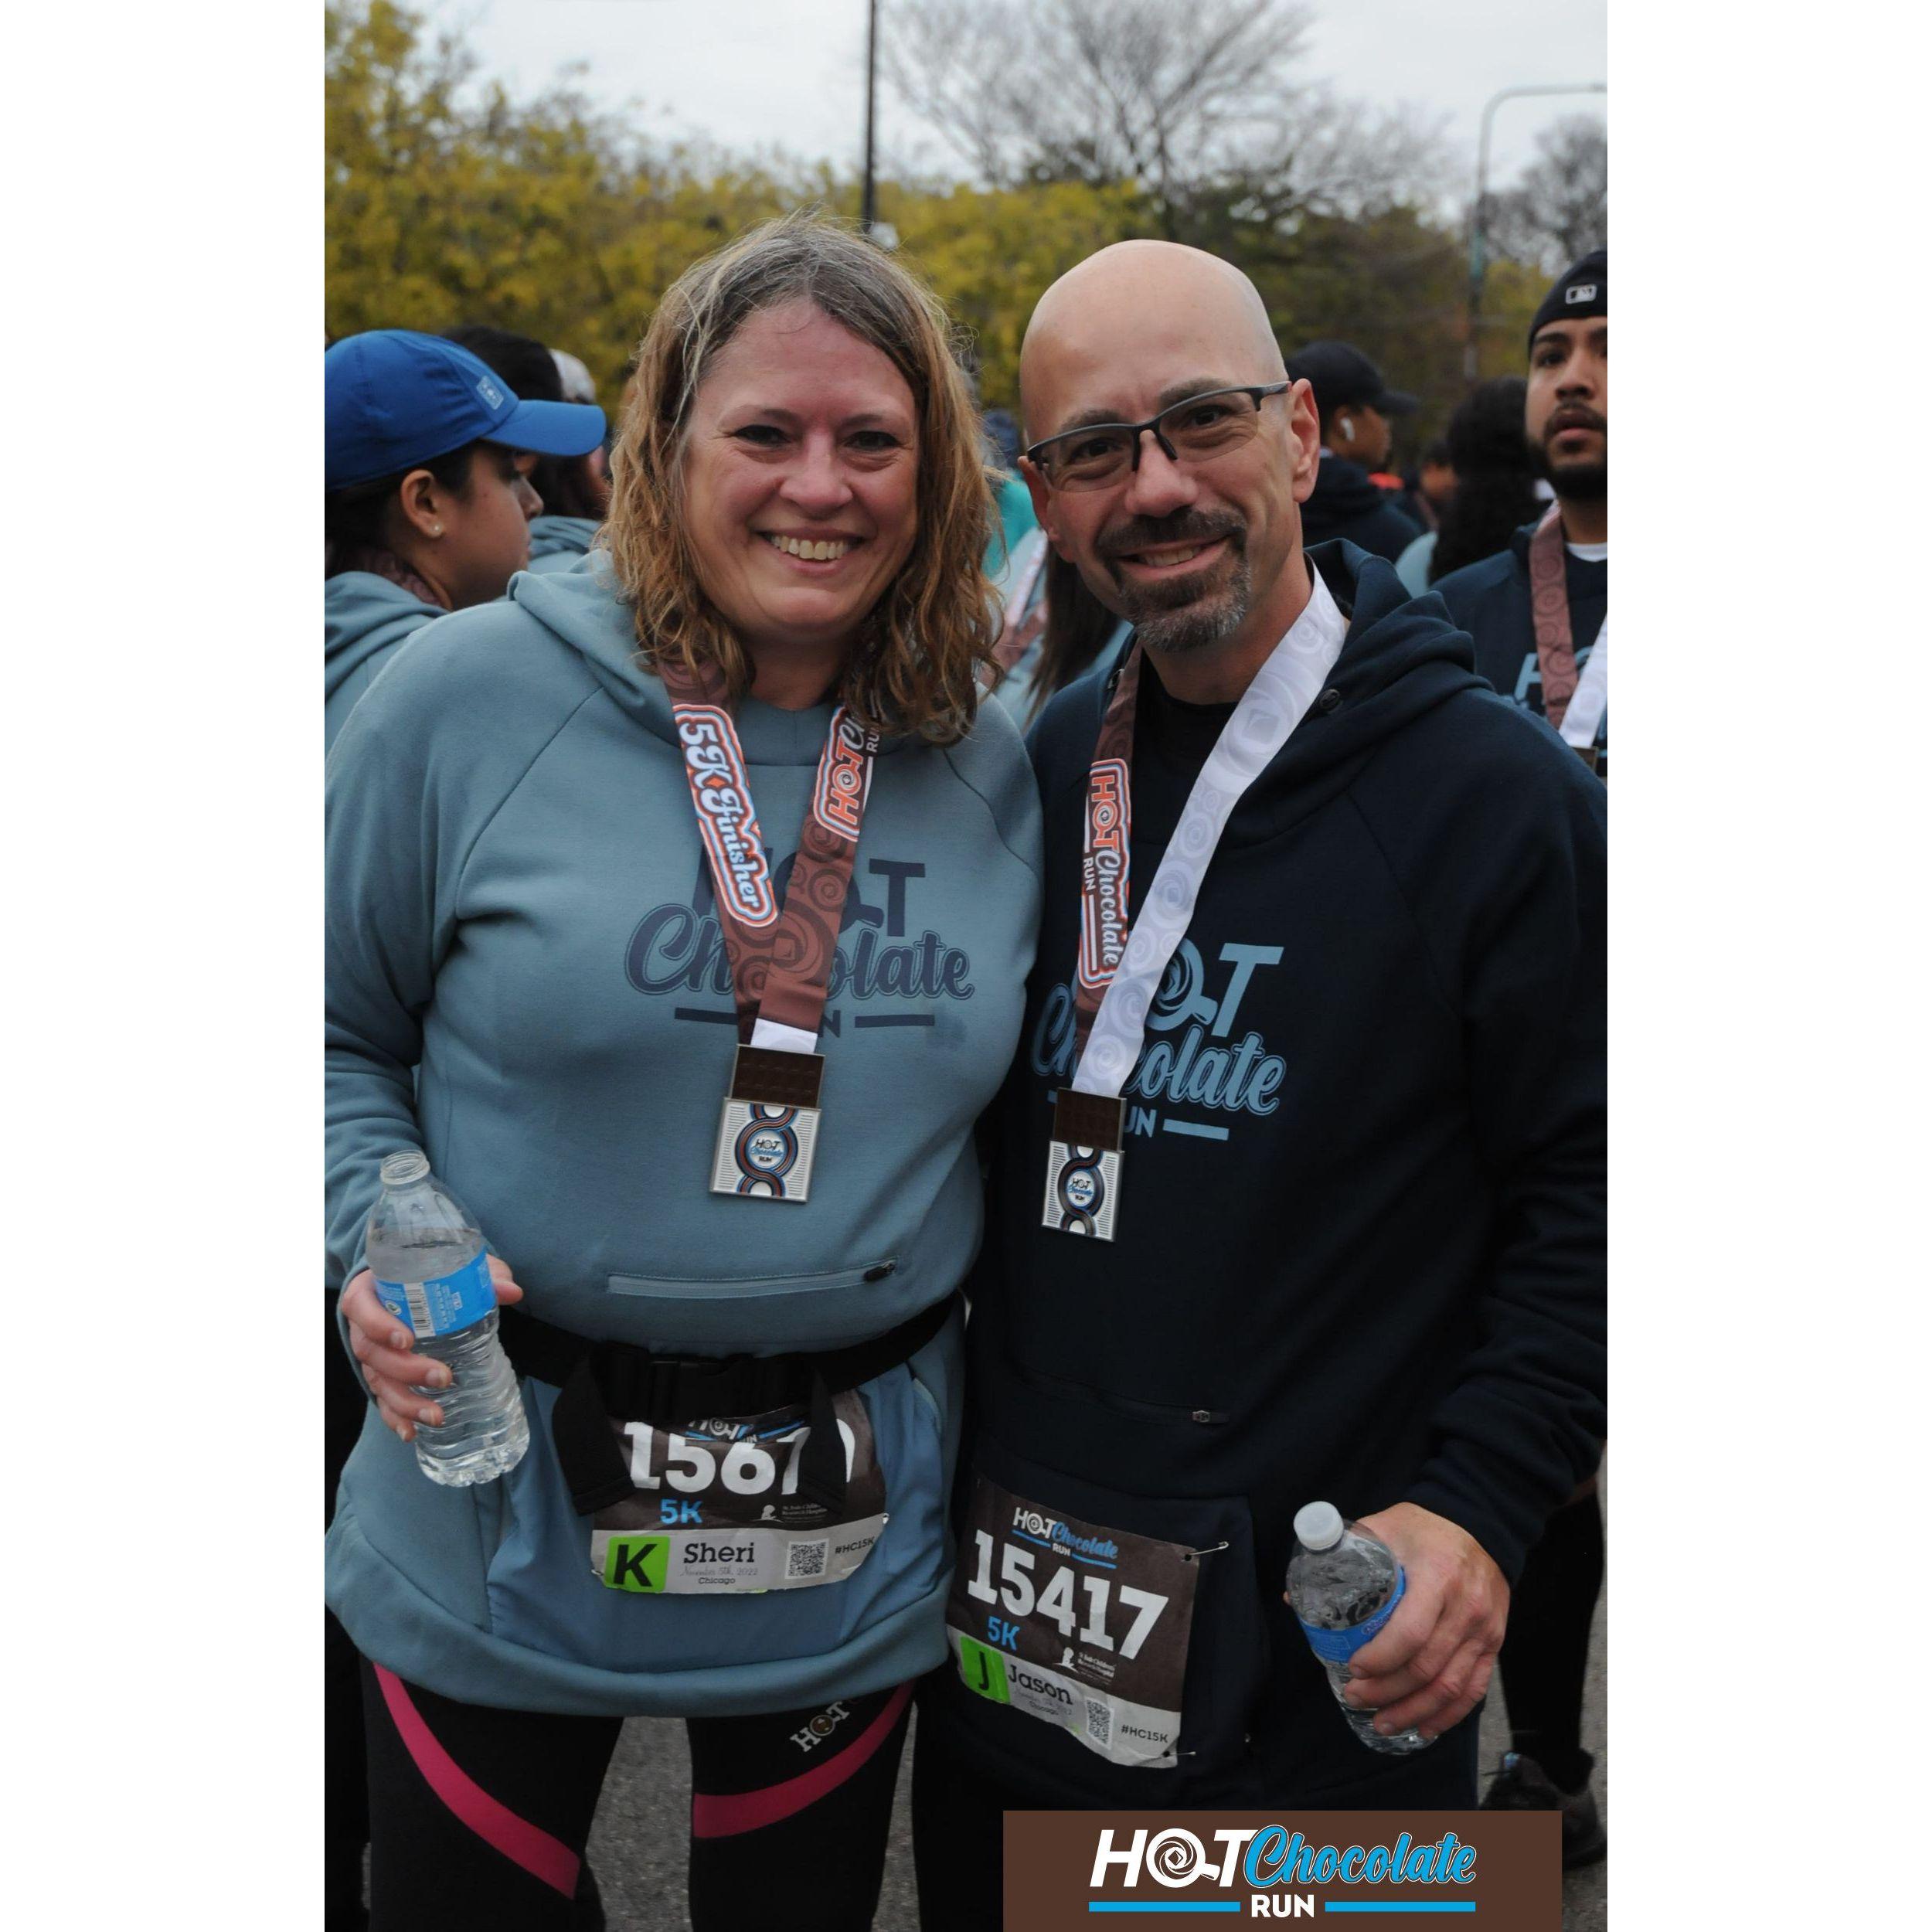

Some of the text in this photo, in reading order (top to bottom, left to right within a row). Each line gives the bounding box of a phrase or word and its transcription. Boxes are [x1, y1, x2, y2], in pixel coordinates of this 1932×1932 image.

[828, 736, 864, 826] HOT
[679, 723, 760, 908] 5K Finisher
[1083, 857, 1096, 892] RUN
[1091, 775, 1124, 966] HOT Chocolate
[1073, 932, 1284, 1038] OT
[1124, 1106, 1157, 1138] UN
[623, 1418, 855, 1495] 1567
[659, 1498, 703, 1525] 5K
[1012, 1507, 1119, 1560] HOT Chocolate
[612, 1542, 755, 1588] K Sheri
[835, 1536, 875, 1555] #HC15K
[1052, 1543, 1071, 1557] RUN
[698, 1577, 736, 1585] Chicago
[968, 1529, 1169, 1660] 15417
[987, 1616, 1021, 1651] 5K
[978, 1651, 989, 1691] J
[1008, 1664, 1073, 1706] Jason
[1121, 1724, 1169, 1743] #HC15K
